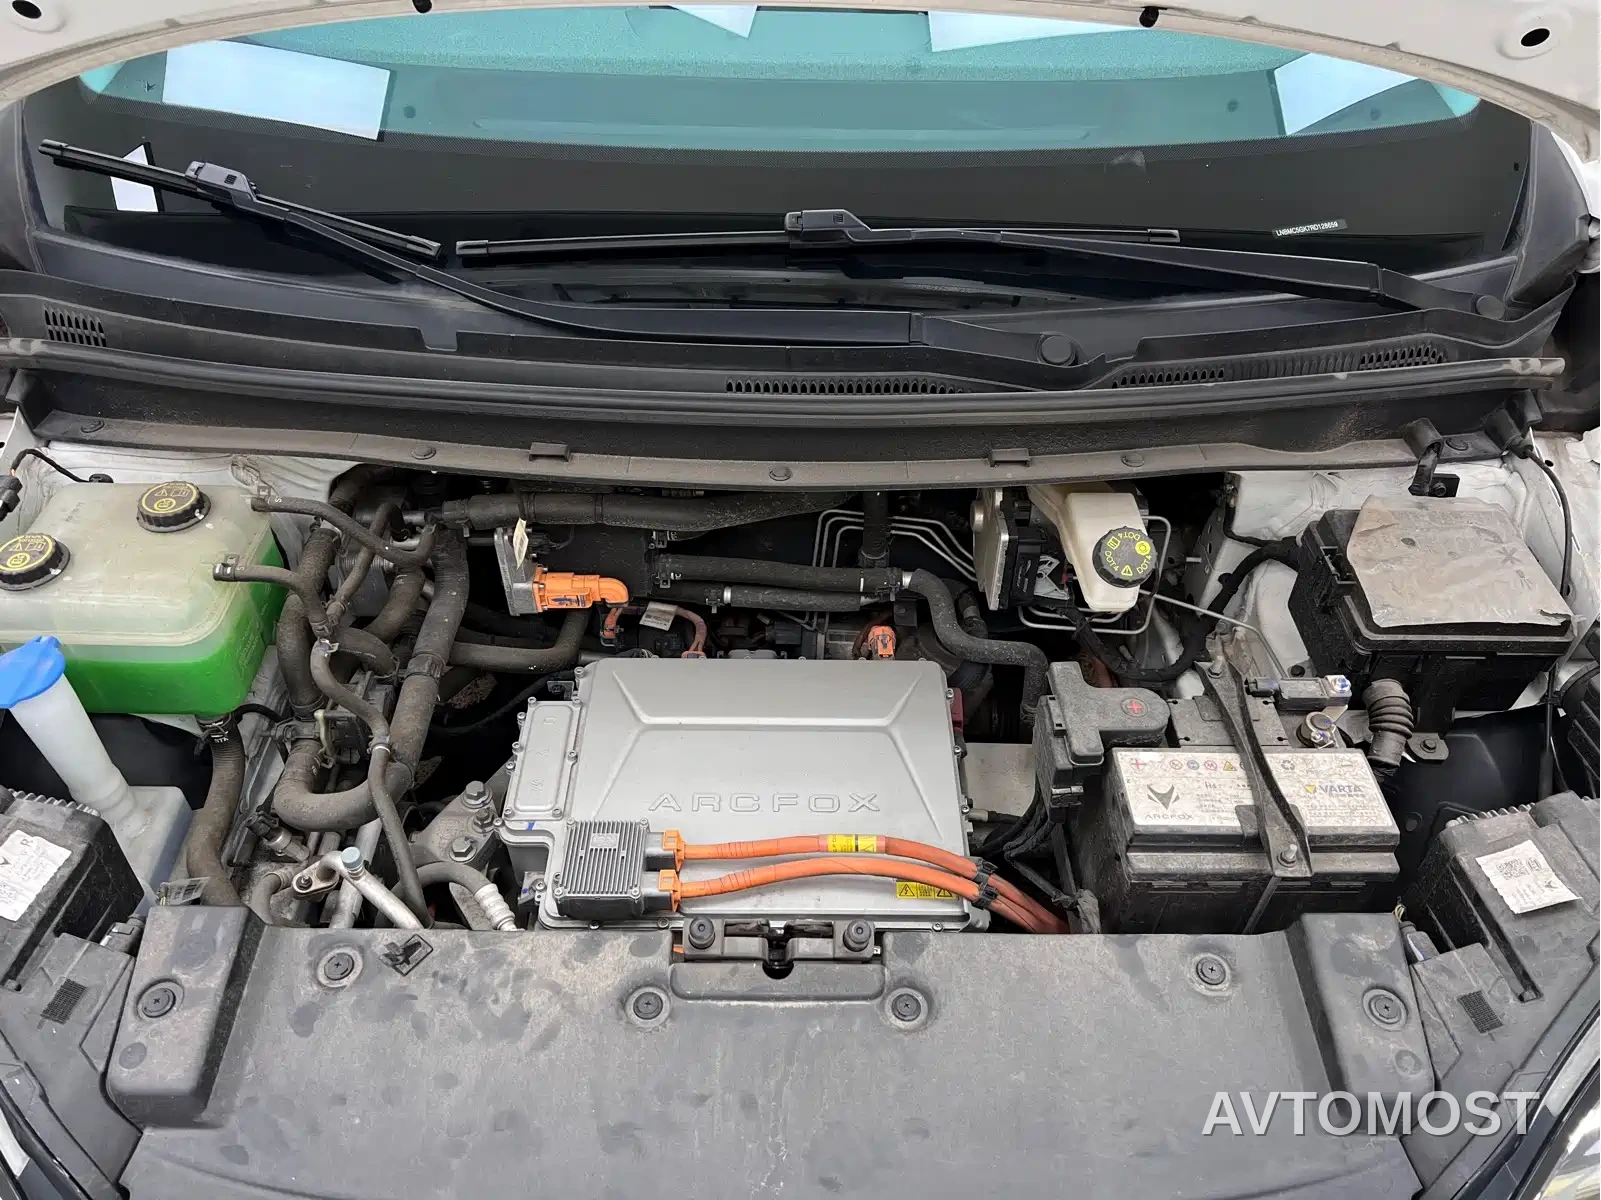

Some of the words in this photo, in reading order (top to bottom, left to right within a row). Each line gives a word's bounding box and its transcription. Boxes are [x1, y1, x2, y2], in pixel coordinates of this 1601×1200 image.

[1117, 531, 1141, 541] DOT4
[1104, 550, 1120, 572] DOT4
[1319, 784, 1364, 794] VARTA
[647, 791, 881, 813] ARCFOX
[1144, 812, 1195, 821] ARCFOX
